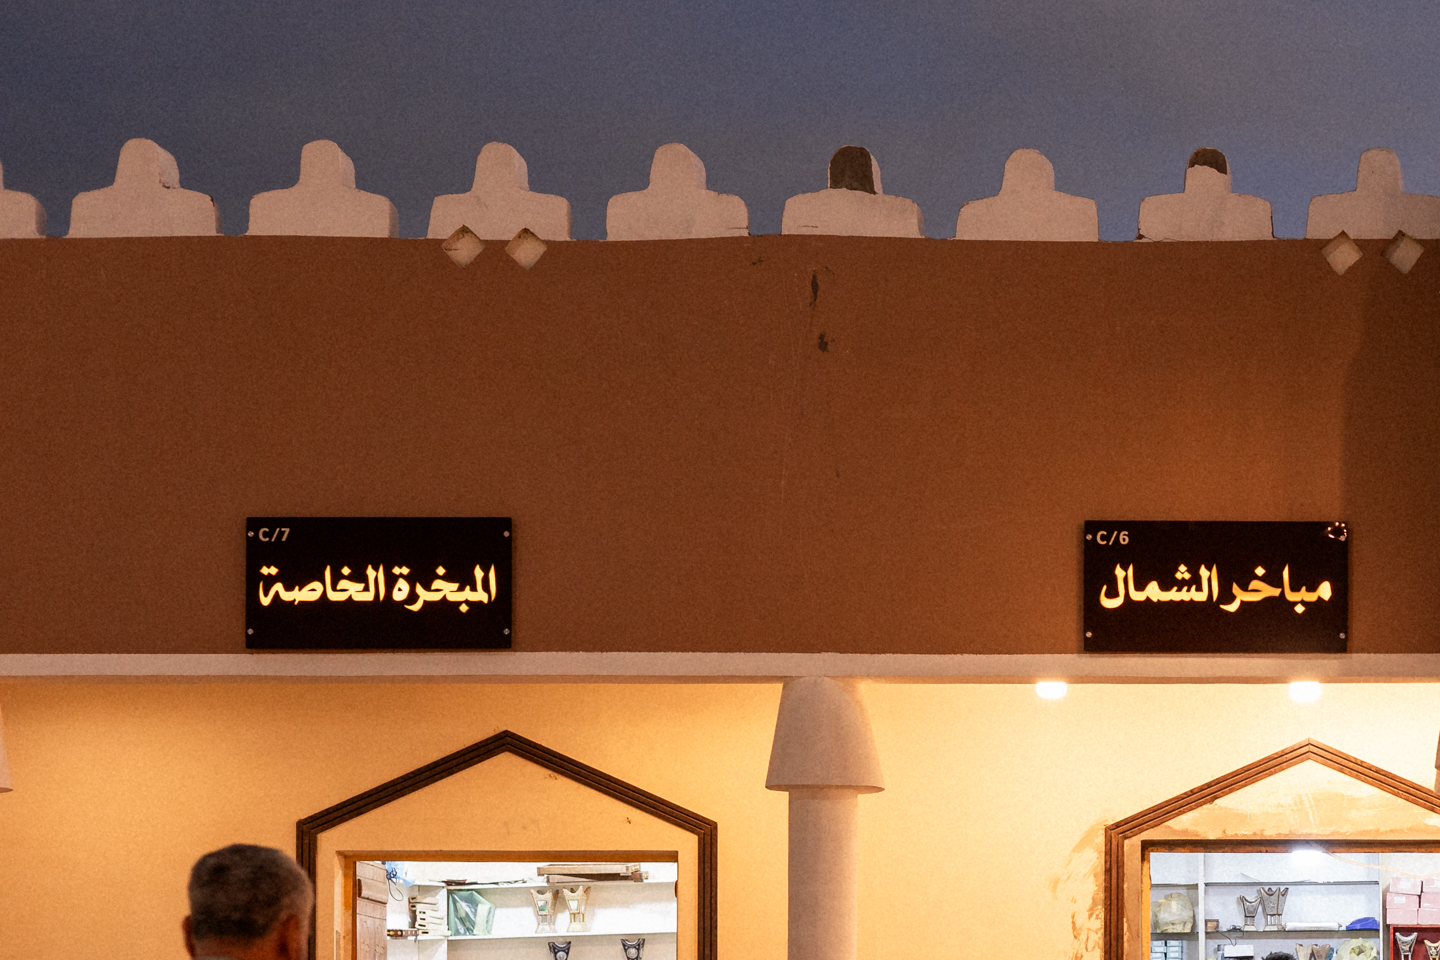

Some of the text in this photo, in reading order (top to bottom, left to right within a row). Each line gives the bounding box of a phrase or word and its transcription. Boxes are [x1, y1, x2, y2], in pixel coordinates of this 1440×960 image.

[258, 527, 290, 542] C/7
[1096, 530, 1130, 545] C/6
[259, 563, 497, 613] المبخرة الخاصة
[1100, 563, 1332, 614] مباخر الشمال
